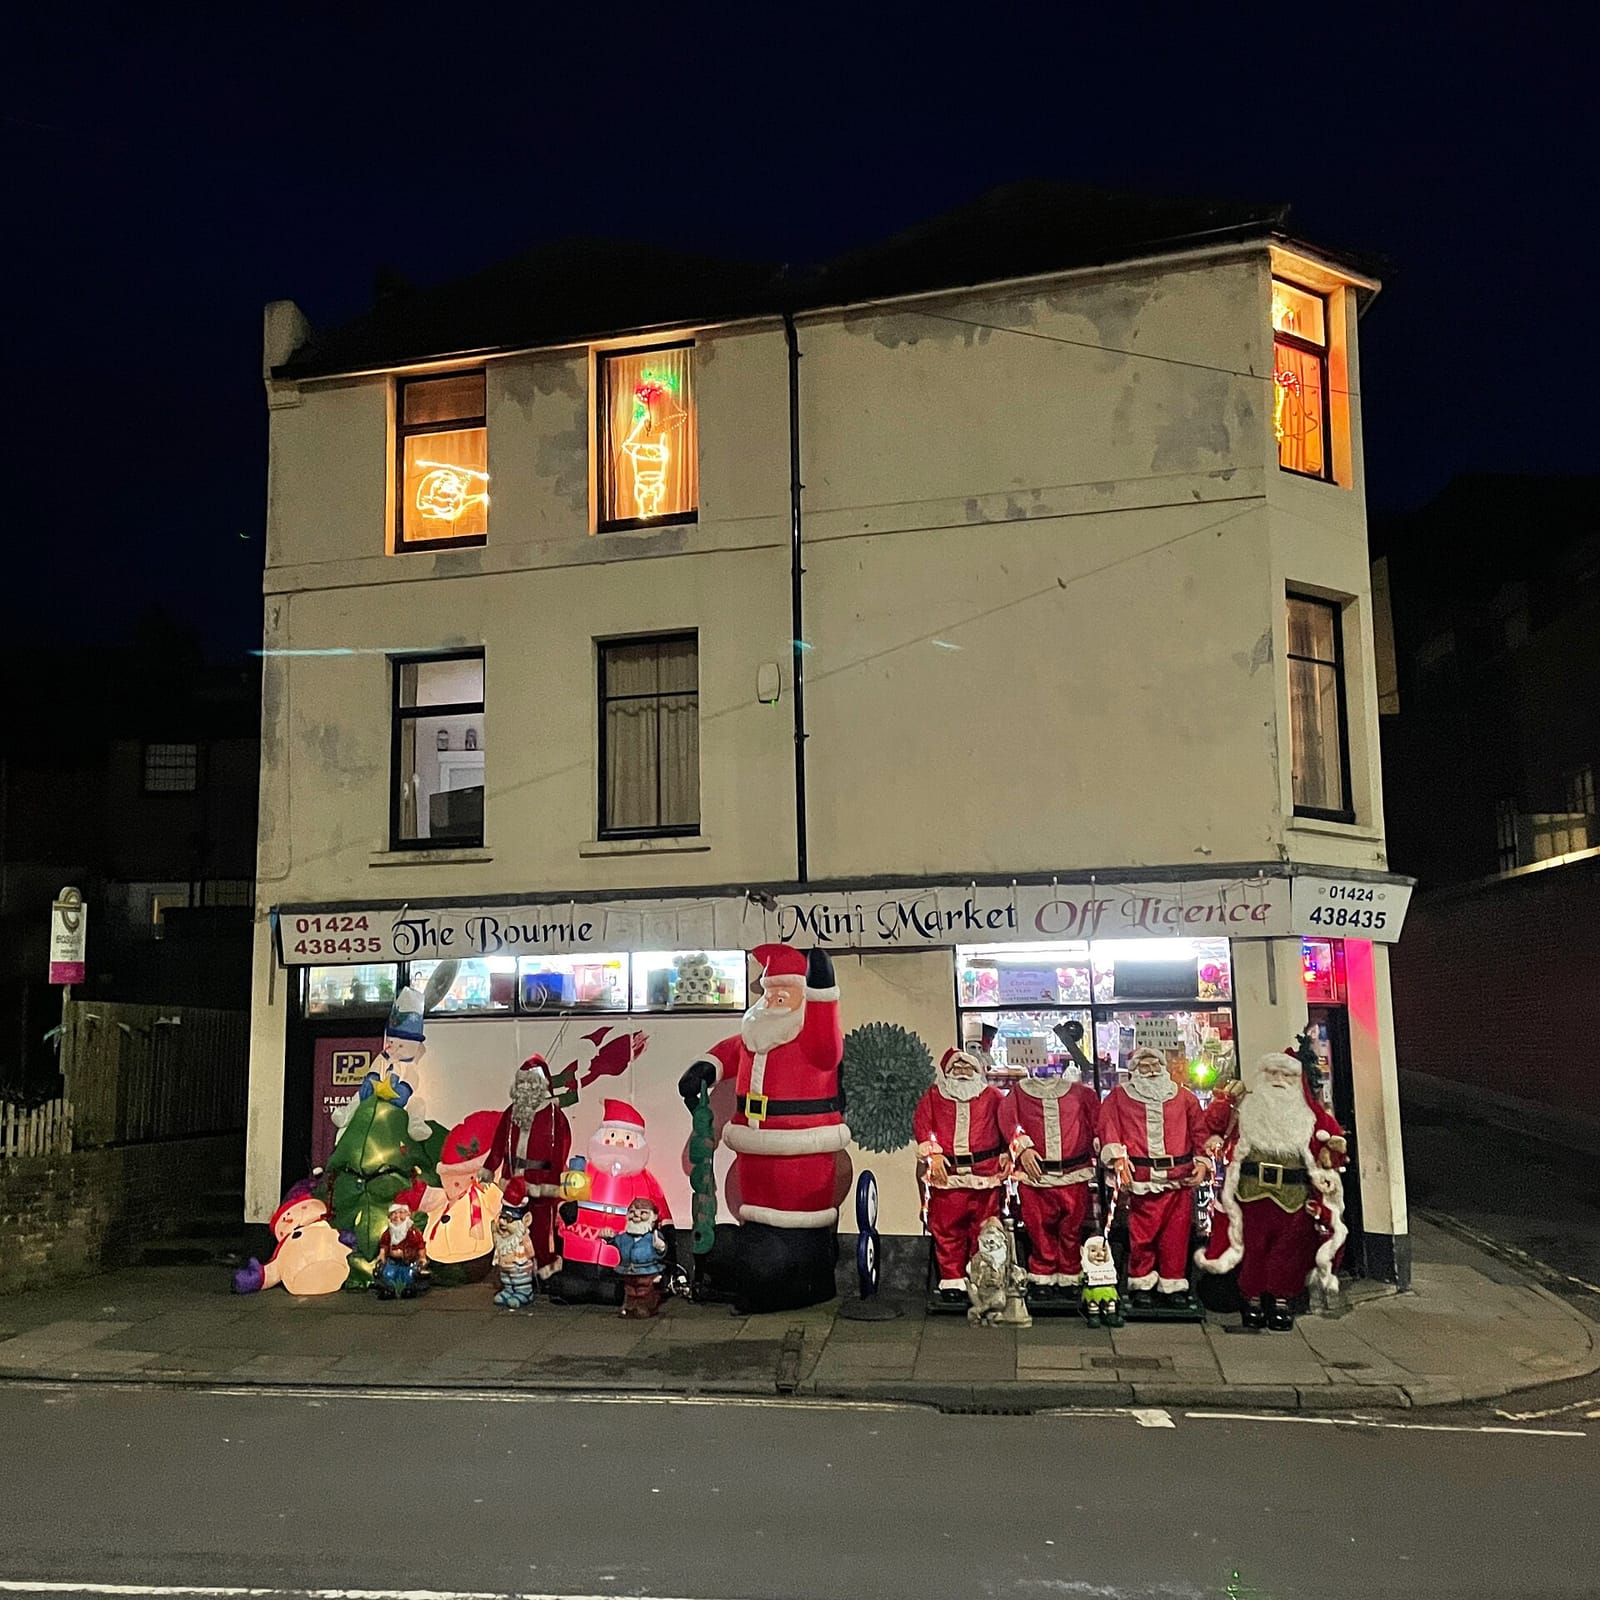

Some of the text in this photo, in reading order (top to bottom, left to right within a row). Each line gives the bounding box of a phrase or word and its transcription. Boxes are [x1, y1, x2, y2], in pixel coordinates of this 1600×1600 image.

[1329, 884, 1374, 902] 01424
[295, 916, 369, 934] 01424
[392, 916, 453, 955] The
[466, 917, 592, 952] Bourne
[779, 904, 865, 942] Mini
[877, 900, 1017, 940] Market
[1034, 899, 1114, 936] Off
[1121, 897, 1272, 935] Licence
[1309, 906, 1387, 930] 438435
[294, 937, 382, 955] 438435
[323, 1096, 353, 1104] PLEAS
